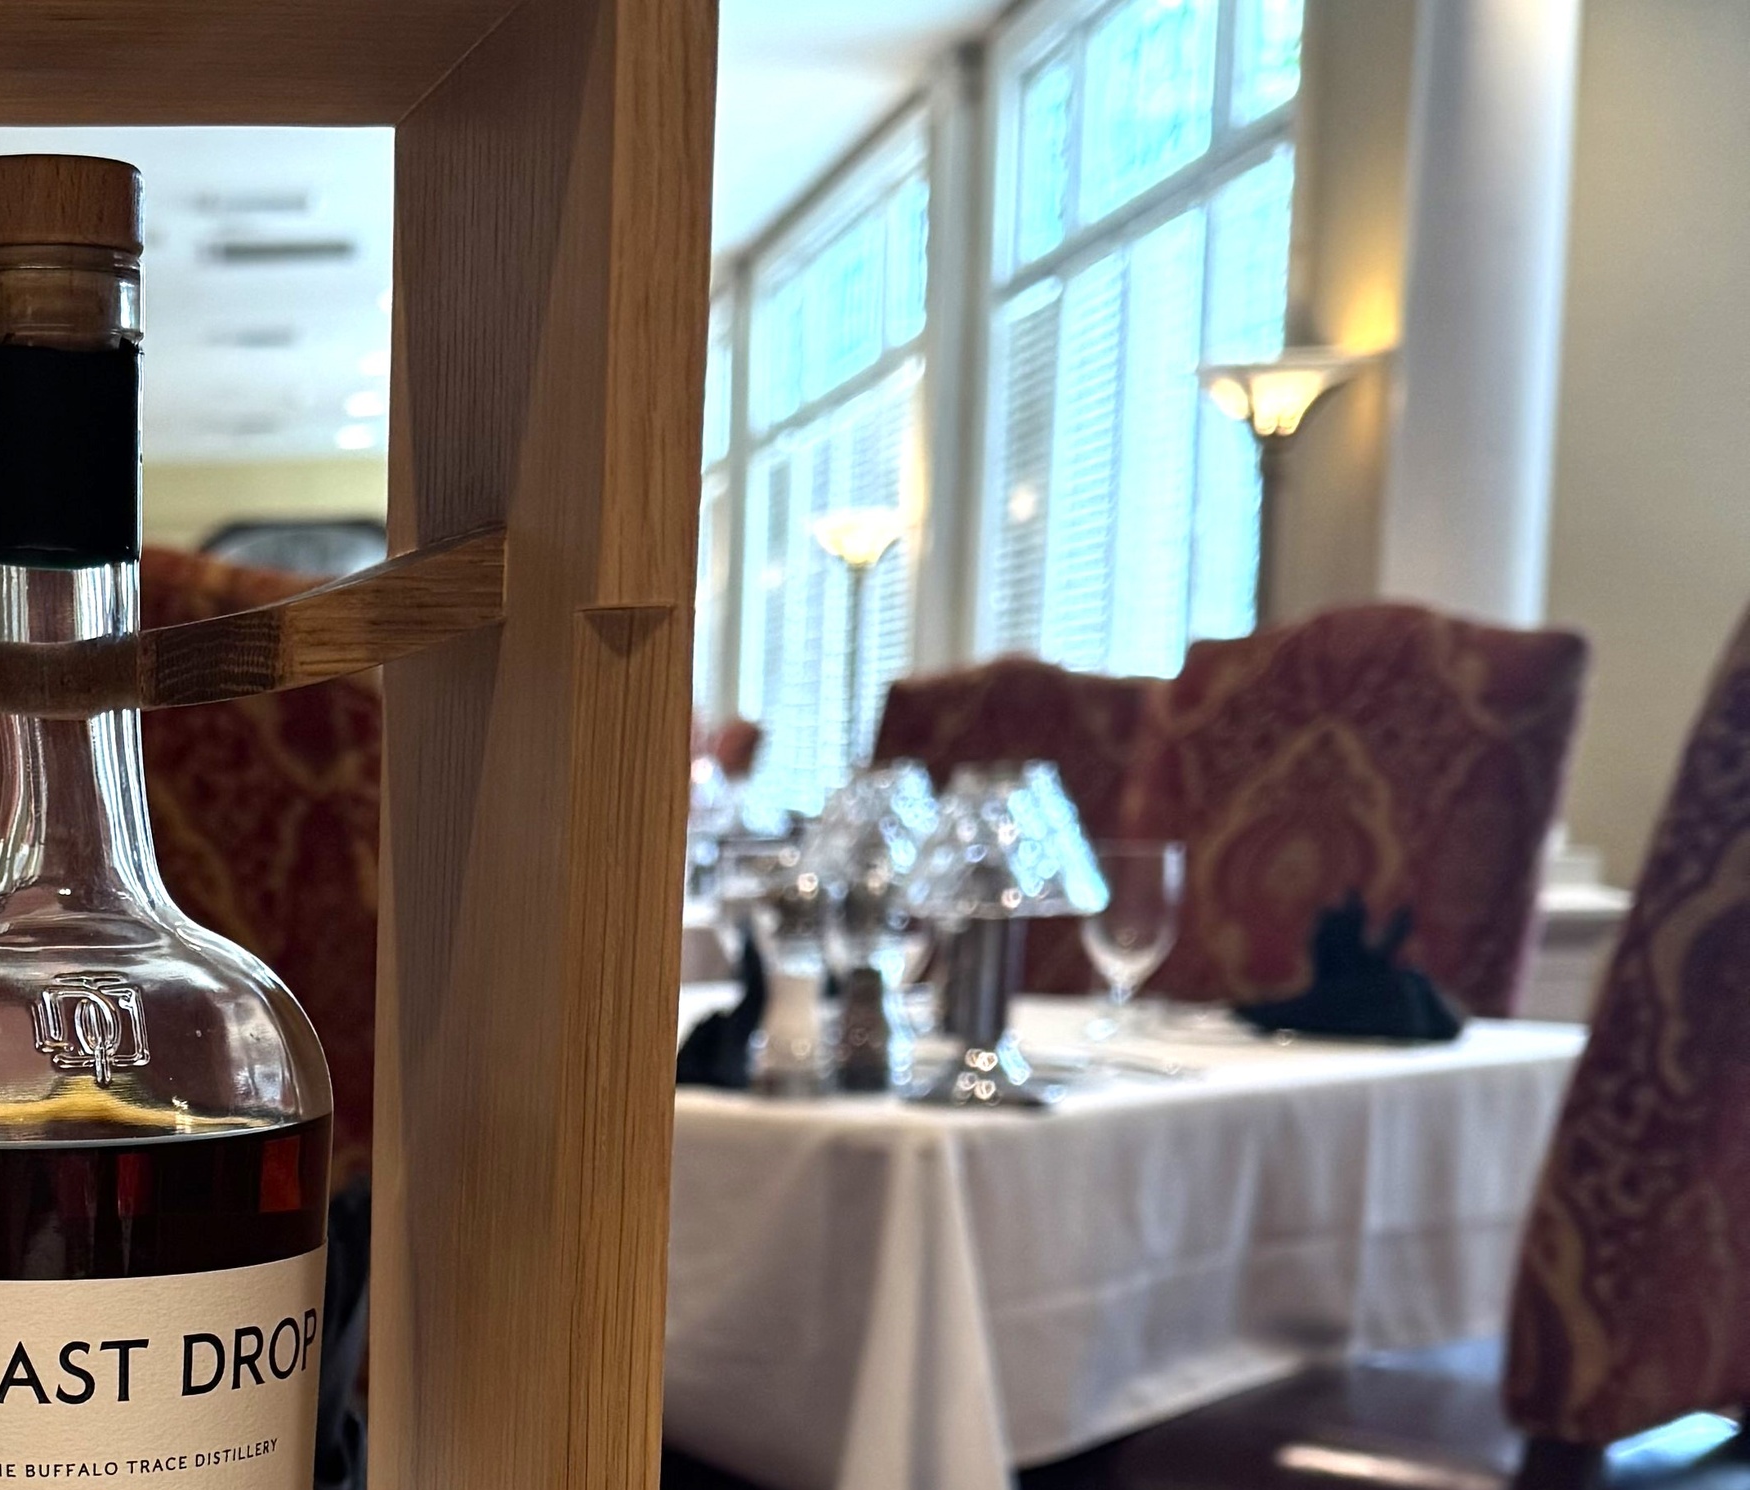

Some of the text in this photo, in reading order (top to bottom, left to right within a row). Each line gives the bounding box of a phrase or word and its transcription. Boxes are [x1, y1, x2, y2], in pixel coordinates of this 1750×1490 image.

[182, 1309, 316, 1396] DROP
[26, 1462, 118, 1477] BUFFALO
[126, 1456, 187, 1474] TRACE
[195, 1438, 277, 1467] DISTILLERY
